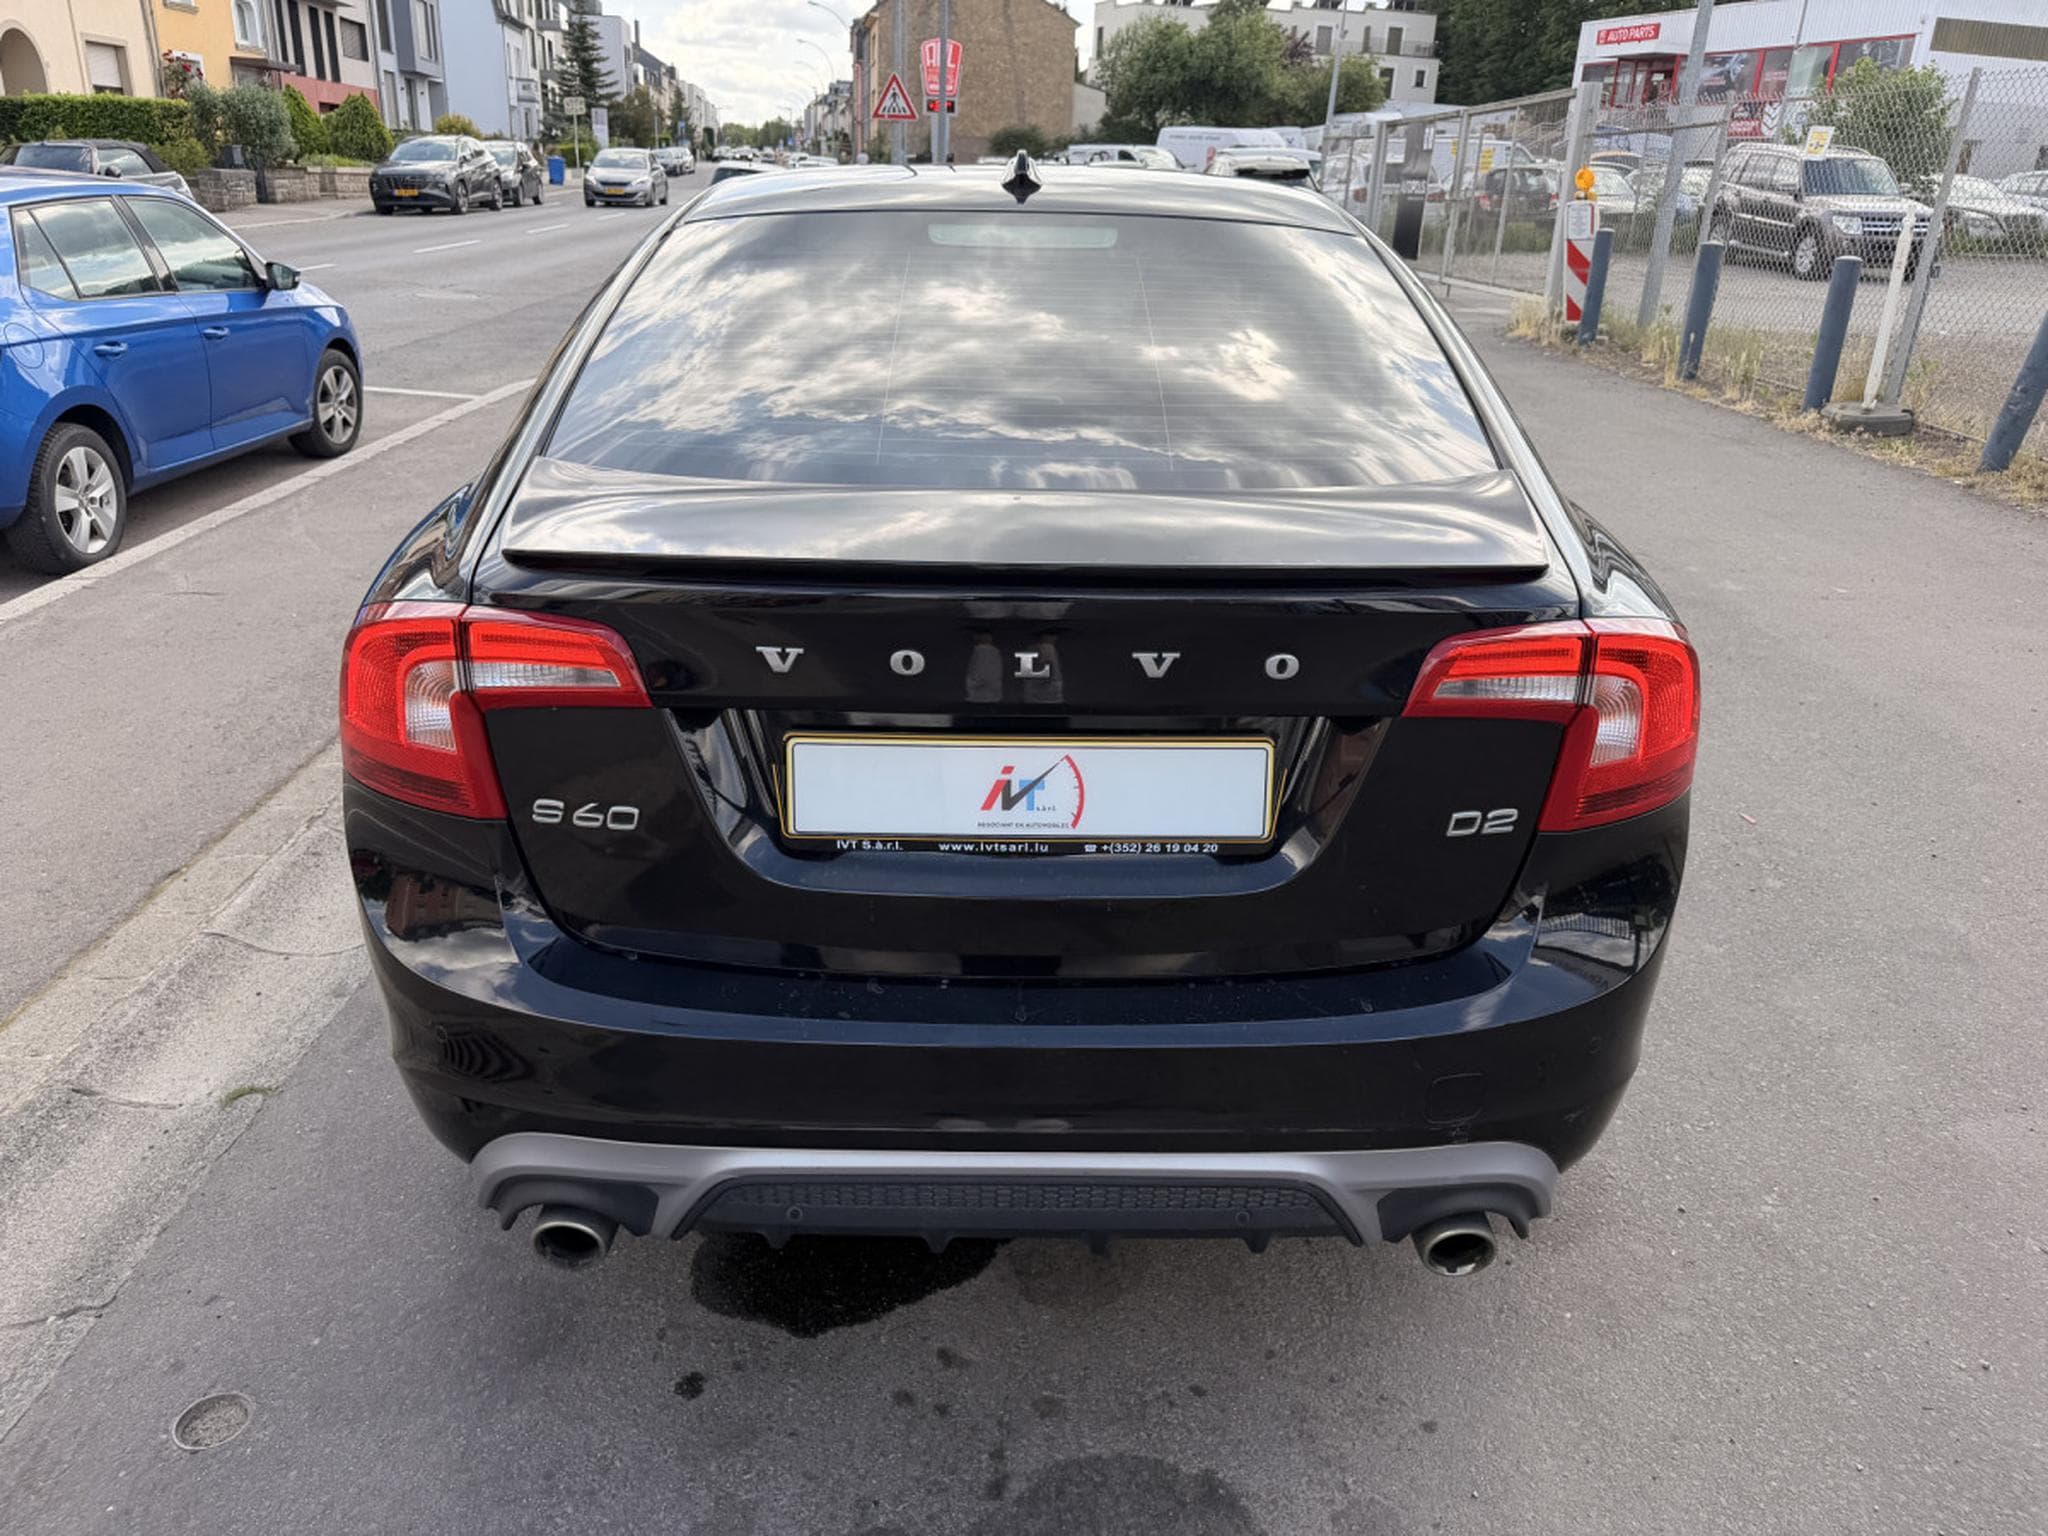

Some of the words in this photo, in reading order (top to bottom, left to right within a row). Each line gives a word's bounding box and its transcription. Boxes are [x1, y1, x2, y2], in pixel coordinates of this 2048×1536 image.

[1629, 25, 1655, 39] PARTS
[756, 646, 1300, 680] VOLVO
[1446, 808, 1518, 837] D2
[836, 839, 857, 850] IVT
[1101, 842, 1141, 854] +(352)
[1145, 843, 1161, 853] 26
[1166, 843, 1180, 853] 19
[1184, 843, 1199, 853] 04
[1203, 843, 1218, 853] 20
